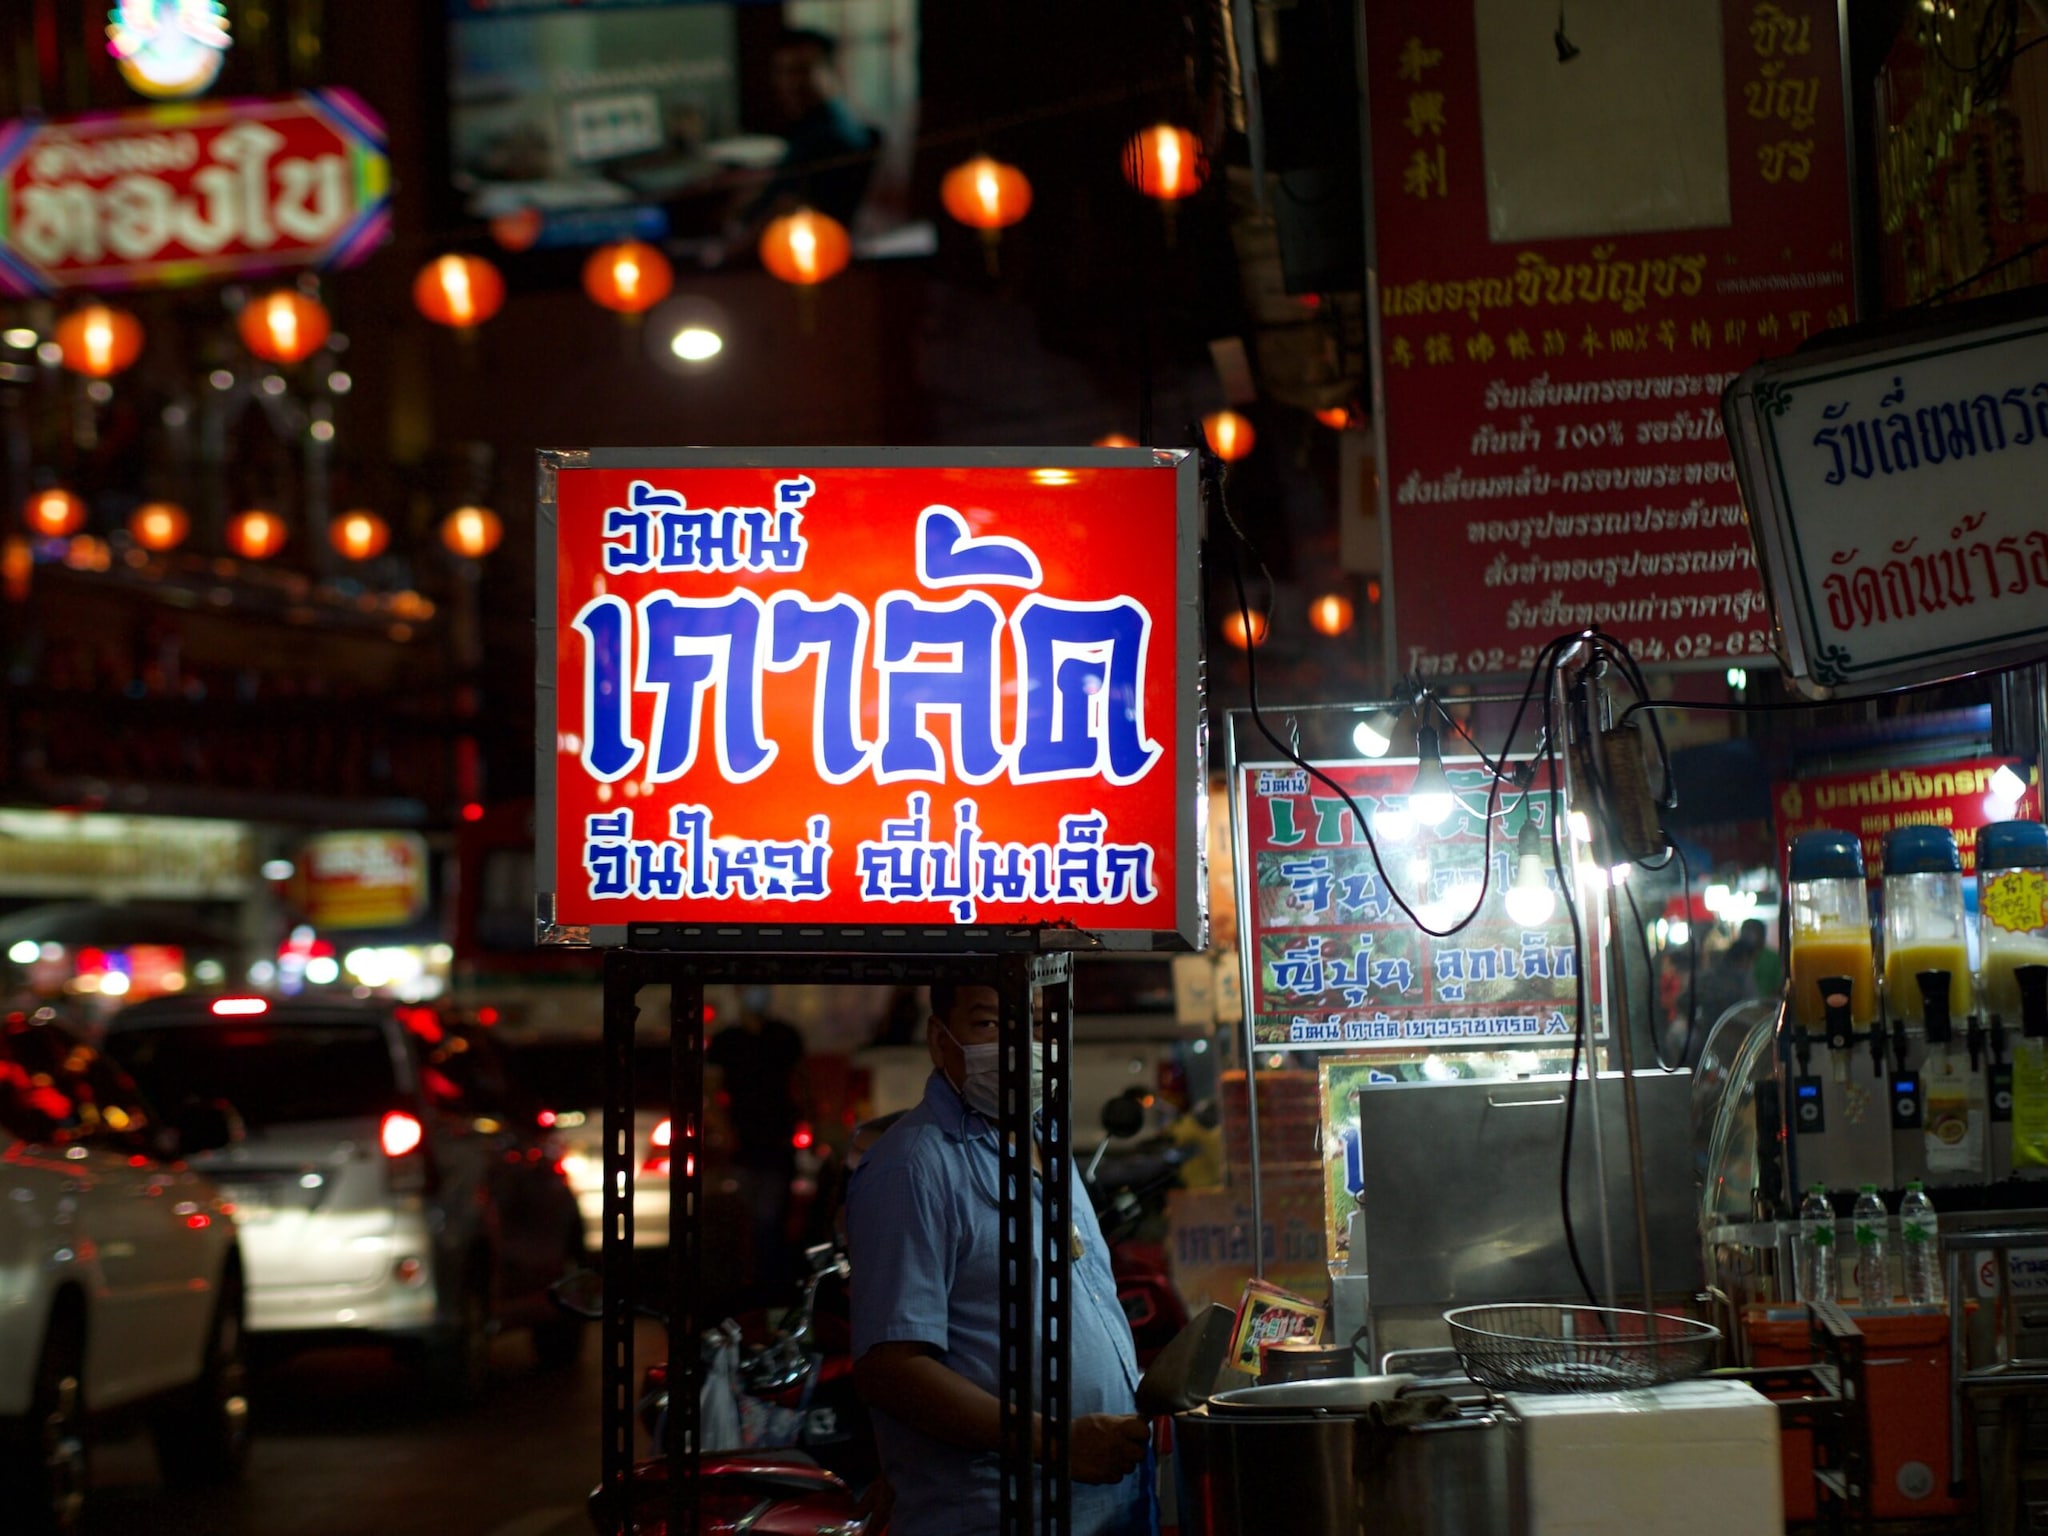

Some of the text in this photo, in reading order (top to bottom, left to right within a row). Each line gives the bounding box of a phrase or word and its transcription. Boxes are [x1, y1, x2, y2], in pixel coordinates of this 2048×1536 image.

[1484, 369, 1740, 411] รับเลี่ยมกรอบพระท
[1554, 420, 1624, 449] 100%
[603, 476, 815, 574] วัฒน์
[572, 504, 1164, 787] เกาลัด
[1257, 771, 1308, 796] วัฒน์
[586, 791, 1159, 924] จีนใหญ่ ญี่ปุ่นเล็ก
[1280, 856, 1394, 918] จีน
[1269, 933, 1414, 1009] ญี่ปุ่น
[1435, 931, 1577, 1001] ลูกเล็ก
[1290, 1014, 1340, 1042] วัฒน์
[1345, 1012, 1402, 1039] เกาลัด
[1544, 1011, 1570, 1035] A
